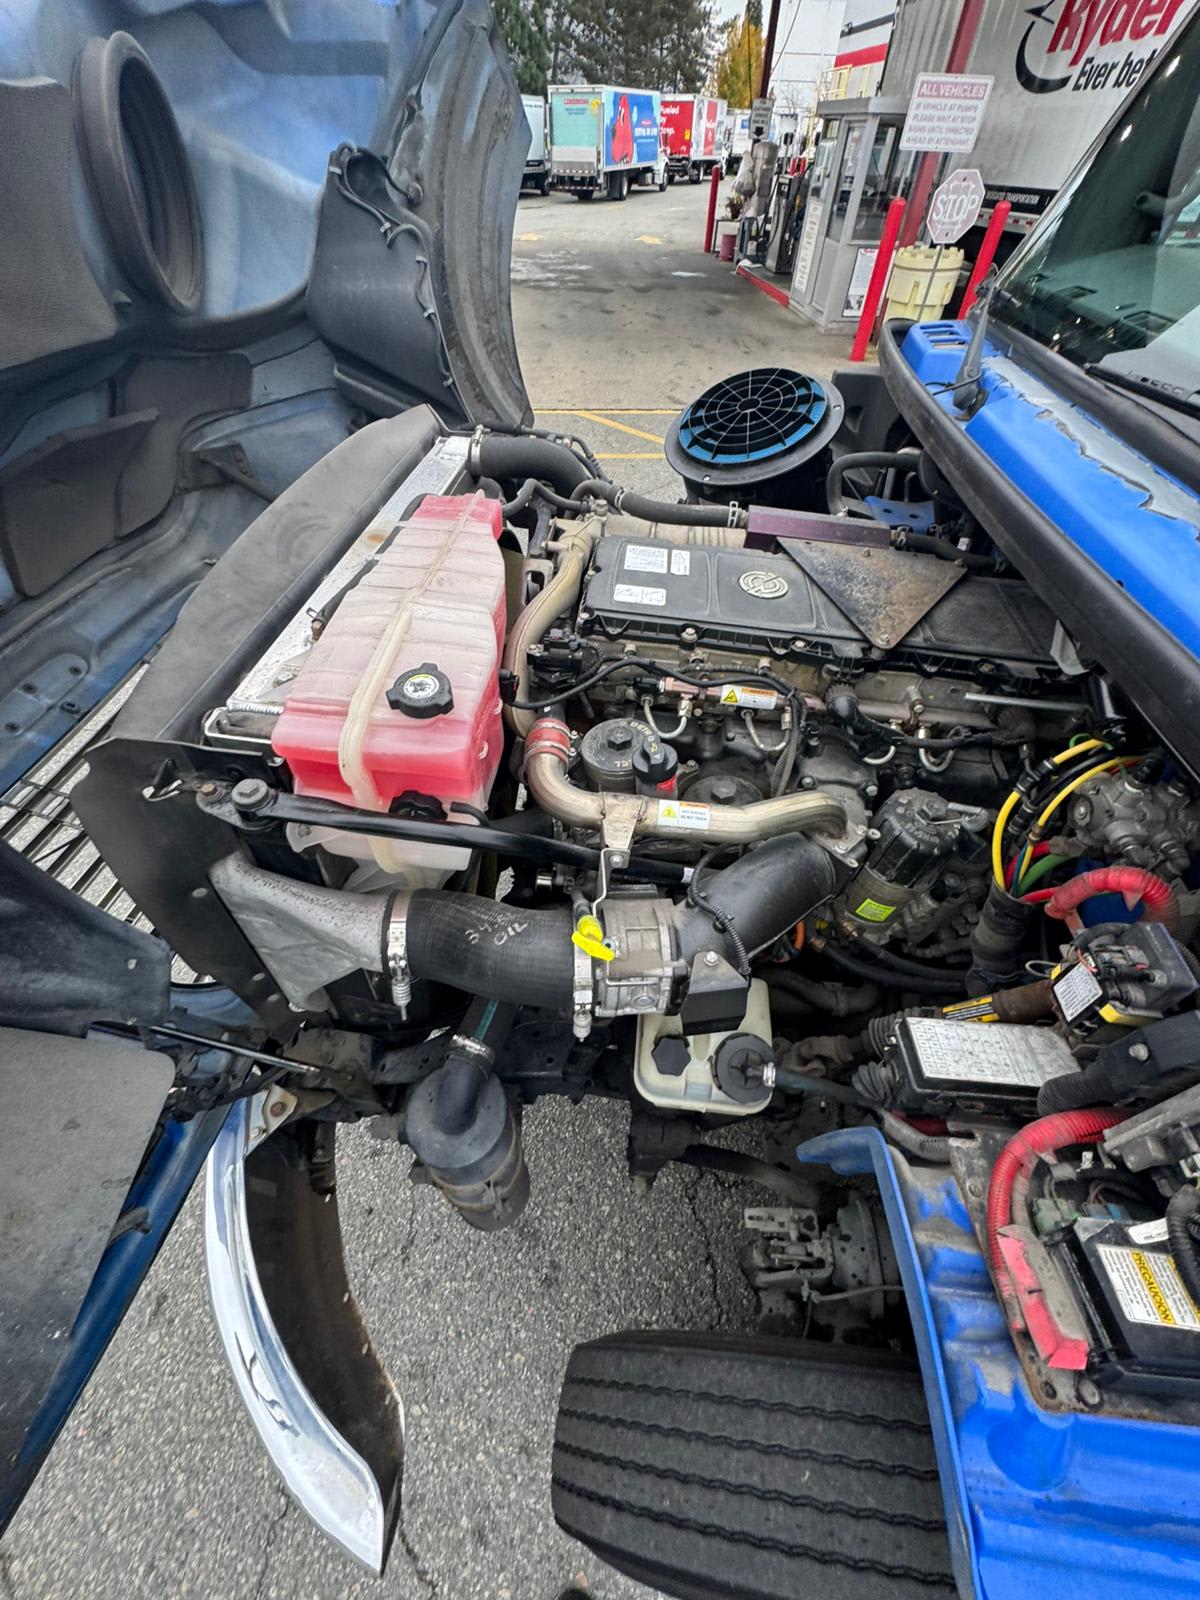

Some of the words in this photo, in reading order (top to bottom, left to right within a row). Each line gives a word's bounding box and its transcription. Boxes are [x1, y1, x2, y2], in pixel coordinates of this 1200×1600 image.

[1046, 0, 1184, 67] Ryder
[1072, 56, 1117, 91] Ever
[920, 83, 938, 97] ALL
[940, 84, 985, 98] VEHICLES
[912, 114, 936, 122] PLEASE
[960, 115, 977, 123] STOP
[922, 103, 948, 111] VEHICLE
[932, 194, 979, 220] STOP
[494, 922, 529, 946] OIL
